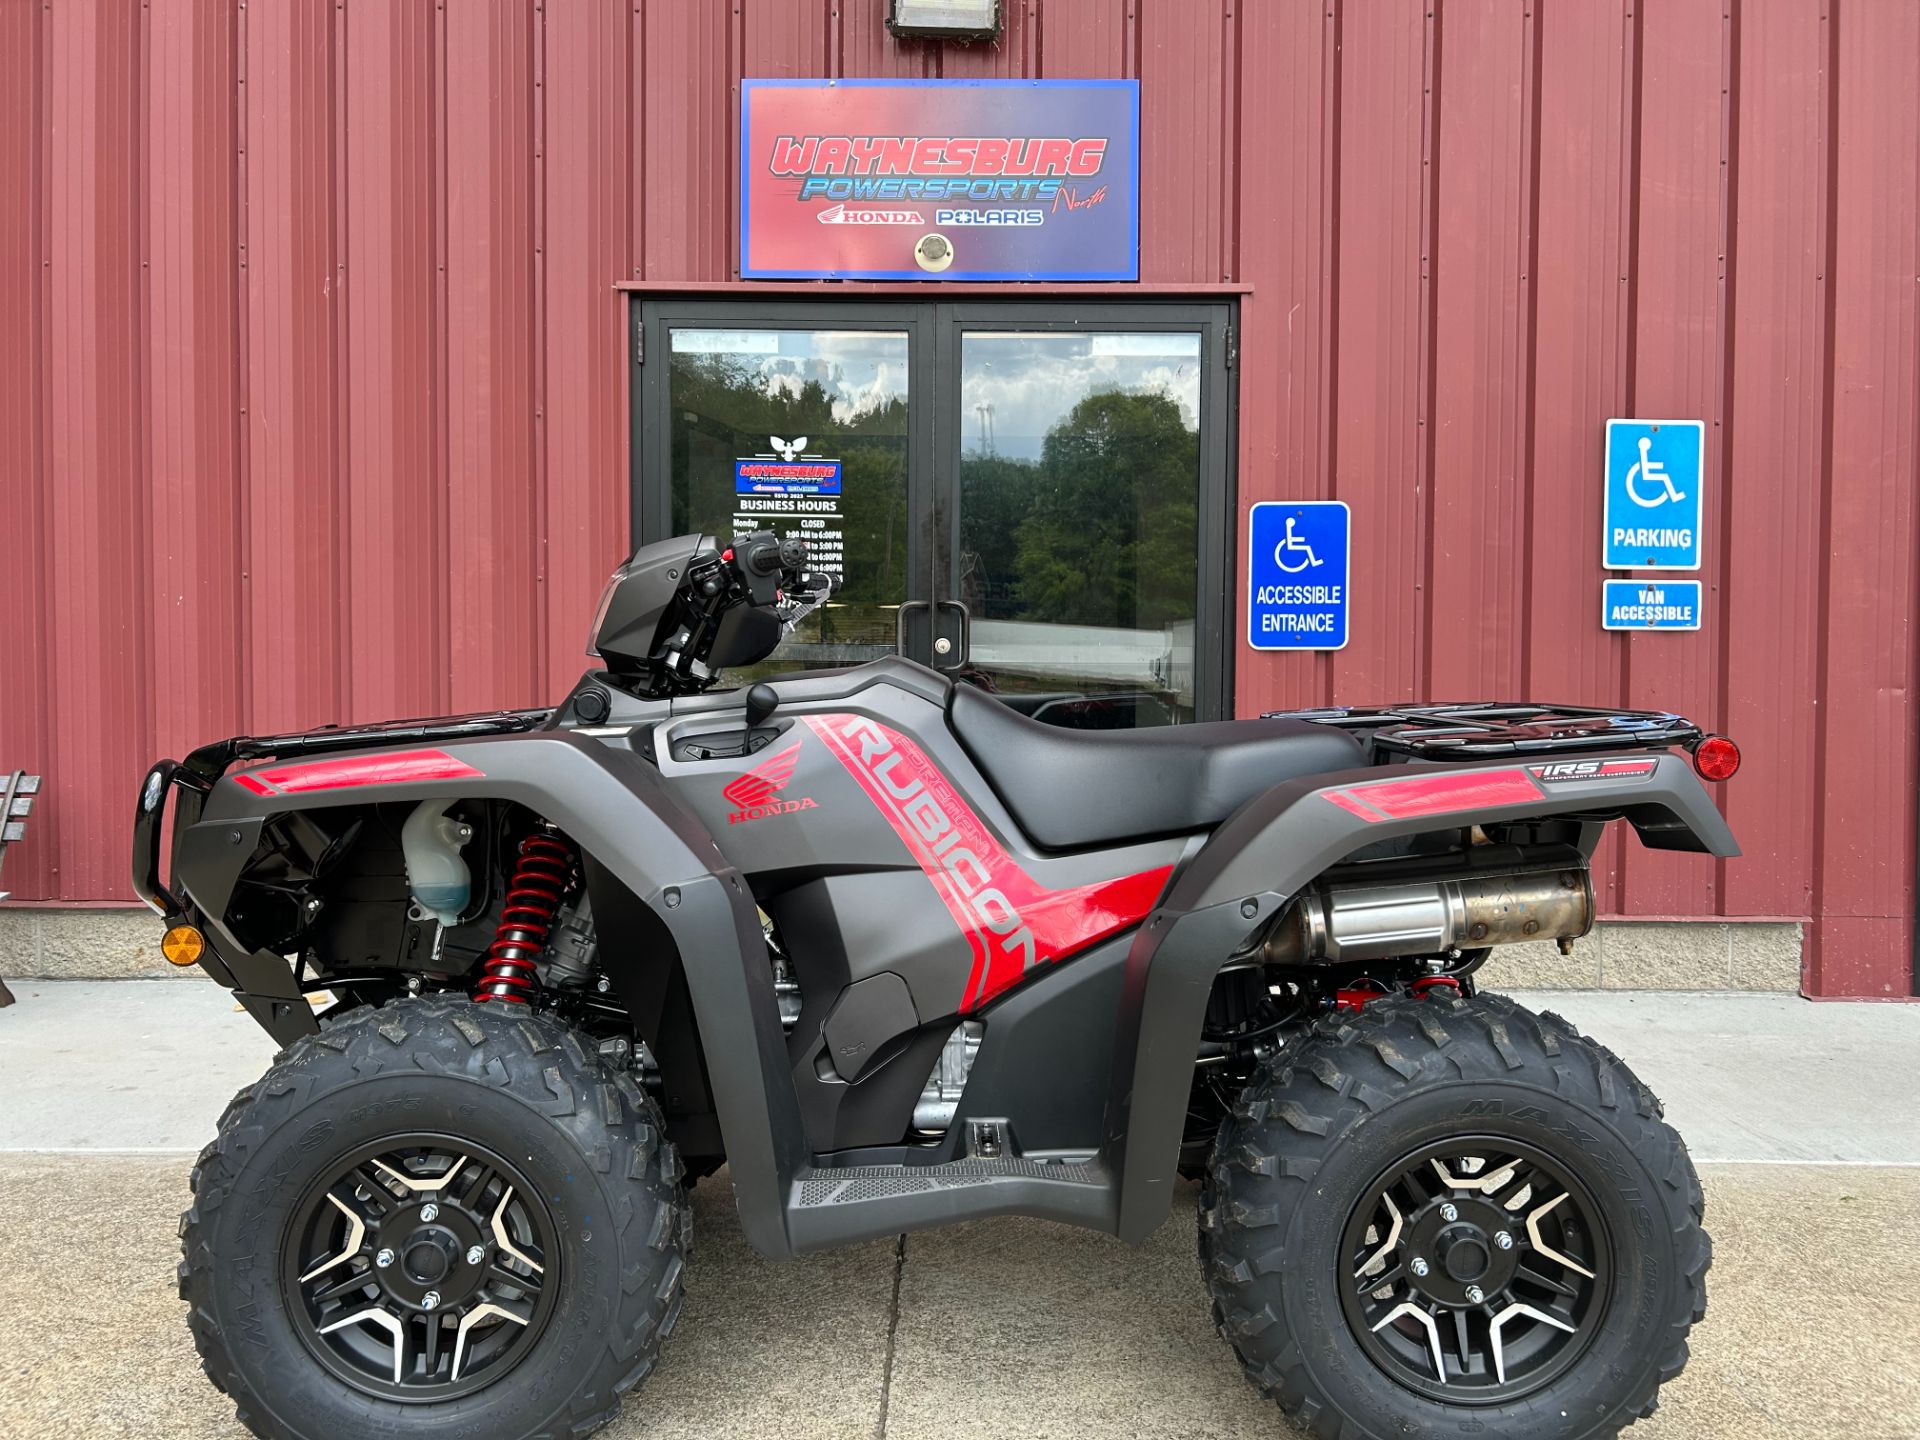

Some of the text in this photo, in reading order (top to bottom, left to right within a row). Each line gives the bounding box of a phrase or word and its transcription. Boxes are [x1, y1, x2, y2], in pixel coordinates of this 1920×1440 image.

[770, 136, 1108, 176] WAYNESBURG
[800, 178, 1064, 201] POWERSPORTS
[1052, 184, 1107, 214] North
[843, 211, 924, 224] HONDA
[937, 210, 1043, 224] POLARIS
[740, 464, 837, 477] WAYNESBURG
[748, 476, 825, 484] POWERSPORTS
[740, 499, 837, 511] BUSINESS HOURS
[733, 518, 759, 529] Monday
[801, 519, 826, 529] CLOSED
[785, 530, 800, 540] 9:00
[811, 531, 818, 539] to
[1613, 528, 1692, 548] PARKING
[811, 542, 818, 550] to
[833, 542, 843, 550] PM
[811, 553, 818, 561] to
[812, 564, 819, 572] to
[1256, 585, 1341, 605] ACCESSIBLE
[1638, 590, 1664, 604] VAN
[1612, 605, 1691, 621] ACCESSIBLE
[1261, 613, 1334, 633] ENTRANCE
[1543, 761, 1599, 776] IRS
[895, 735, 988, 853] FOREMAN
[727, 796, 819, 825] HONDA
[1457, 1098, 1657, 1241] MAXXIS
